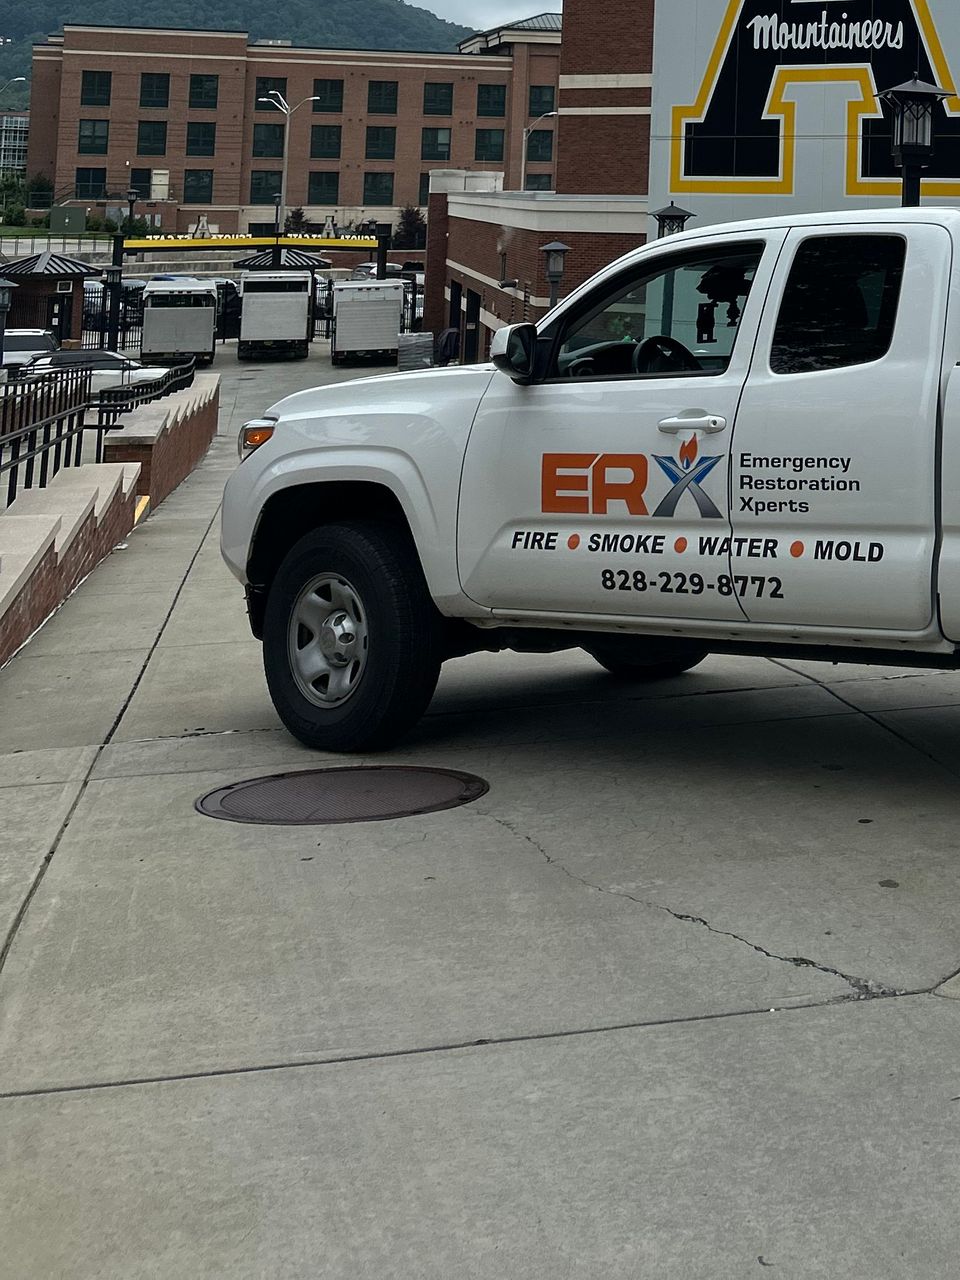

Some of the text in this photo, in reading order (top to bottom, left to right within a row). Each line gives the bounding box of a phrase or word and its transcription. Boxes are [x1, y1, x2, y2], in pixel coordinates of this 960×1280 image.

[746, 10, 904, 50] Mountaineers
[739, 453, 852, 472] Emergency
[541, 453, 725, 518] ERX
[739, 475, 861, 492] Restoration
[739, 497, 810, 516] Xperts
[511, 531, 885, 563] FIRE SMOKE WATER MOLD
[601, 569, 785, 600] 828-229-8772
